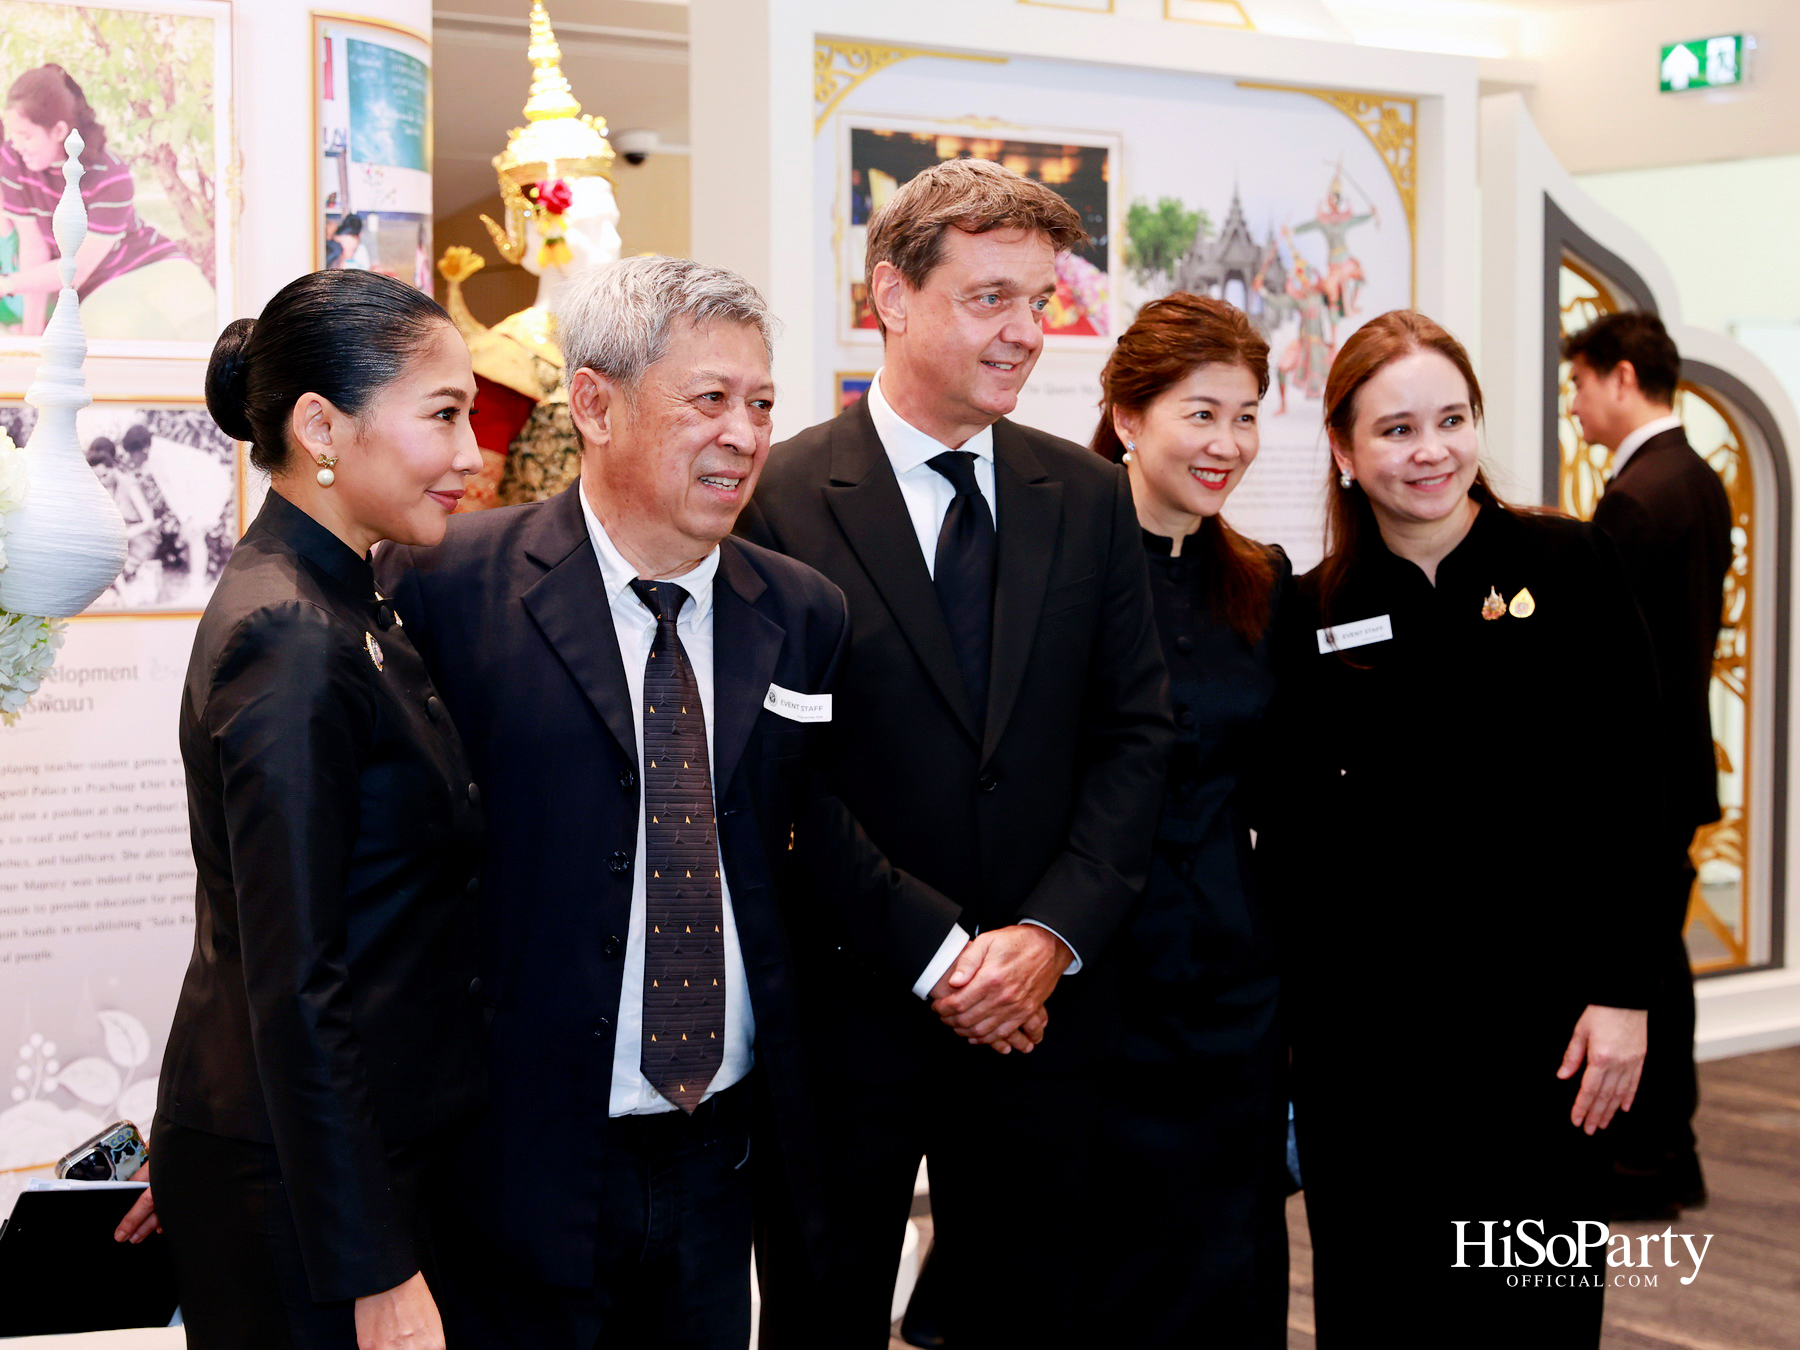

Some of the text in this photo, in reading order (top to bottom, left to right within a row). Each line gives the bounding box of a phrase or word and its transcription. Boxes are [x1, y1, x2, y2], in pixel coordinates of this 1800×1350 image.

[1342, 631, 1362, 640] EVENT
[1364, 626, 1383, 635] STAFF
[780, 699, 800, 710] EVENT
